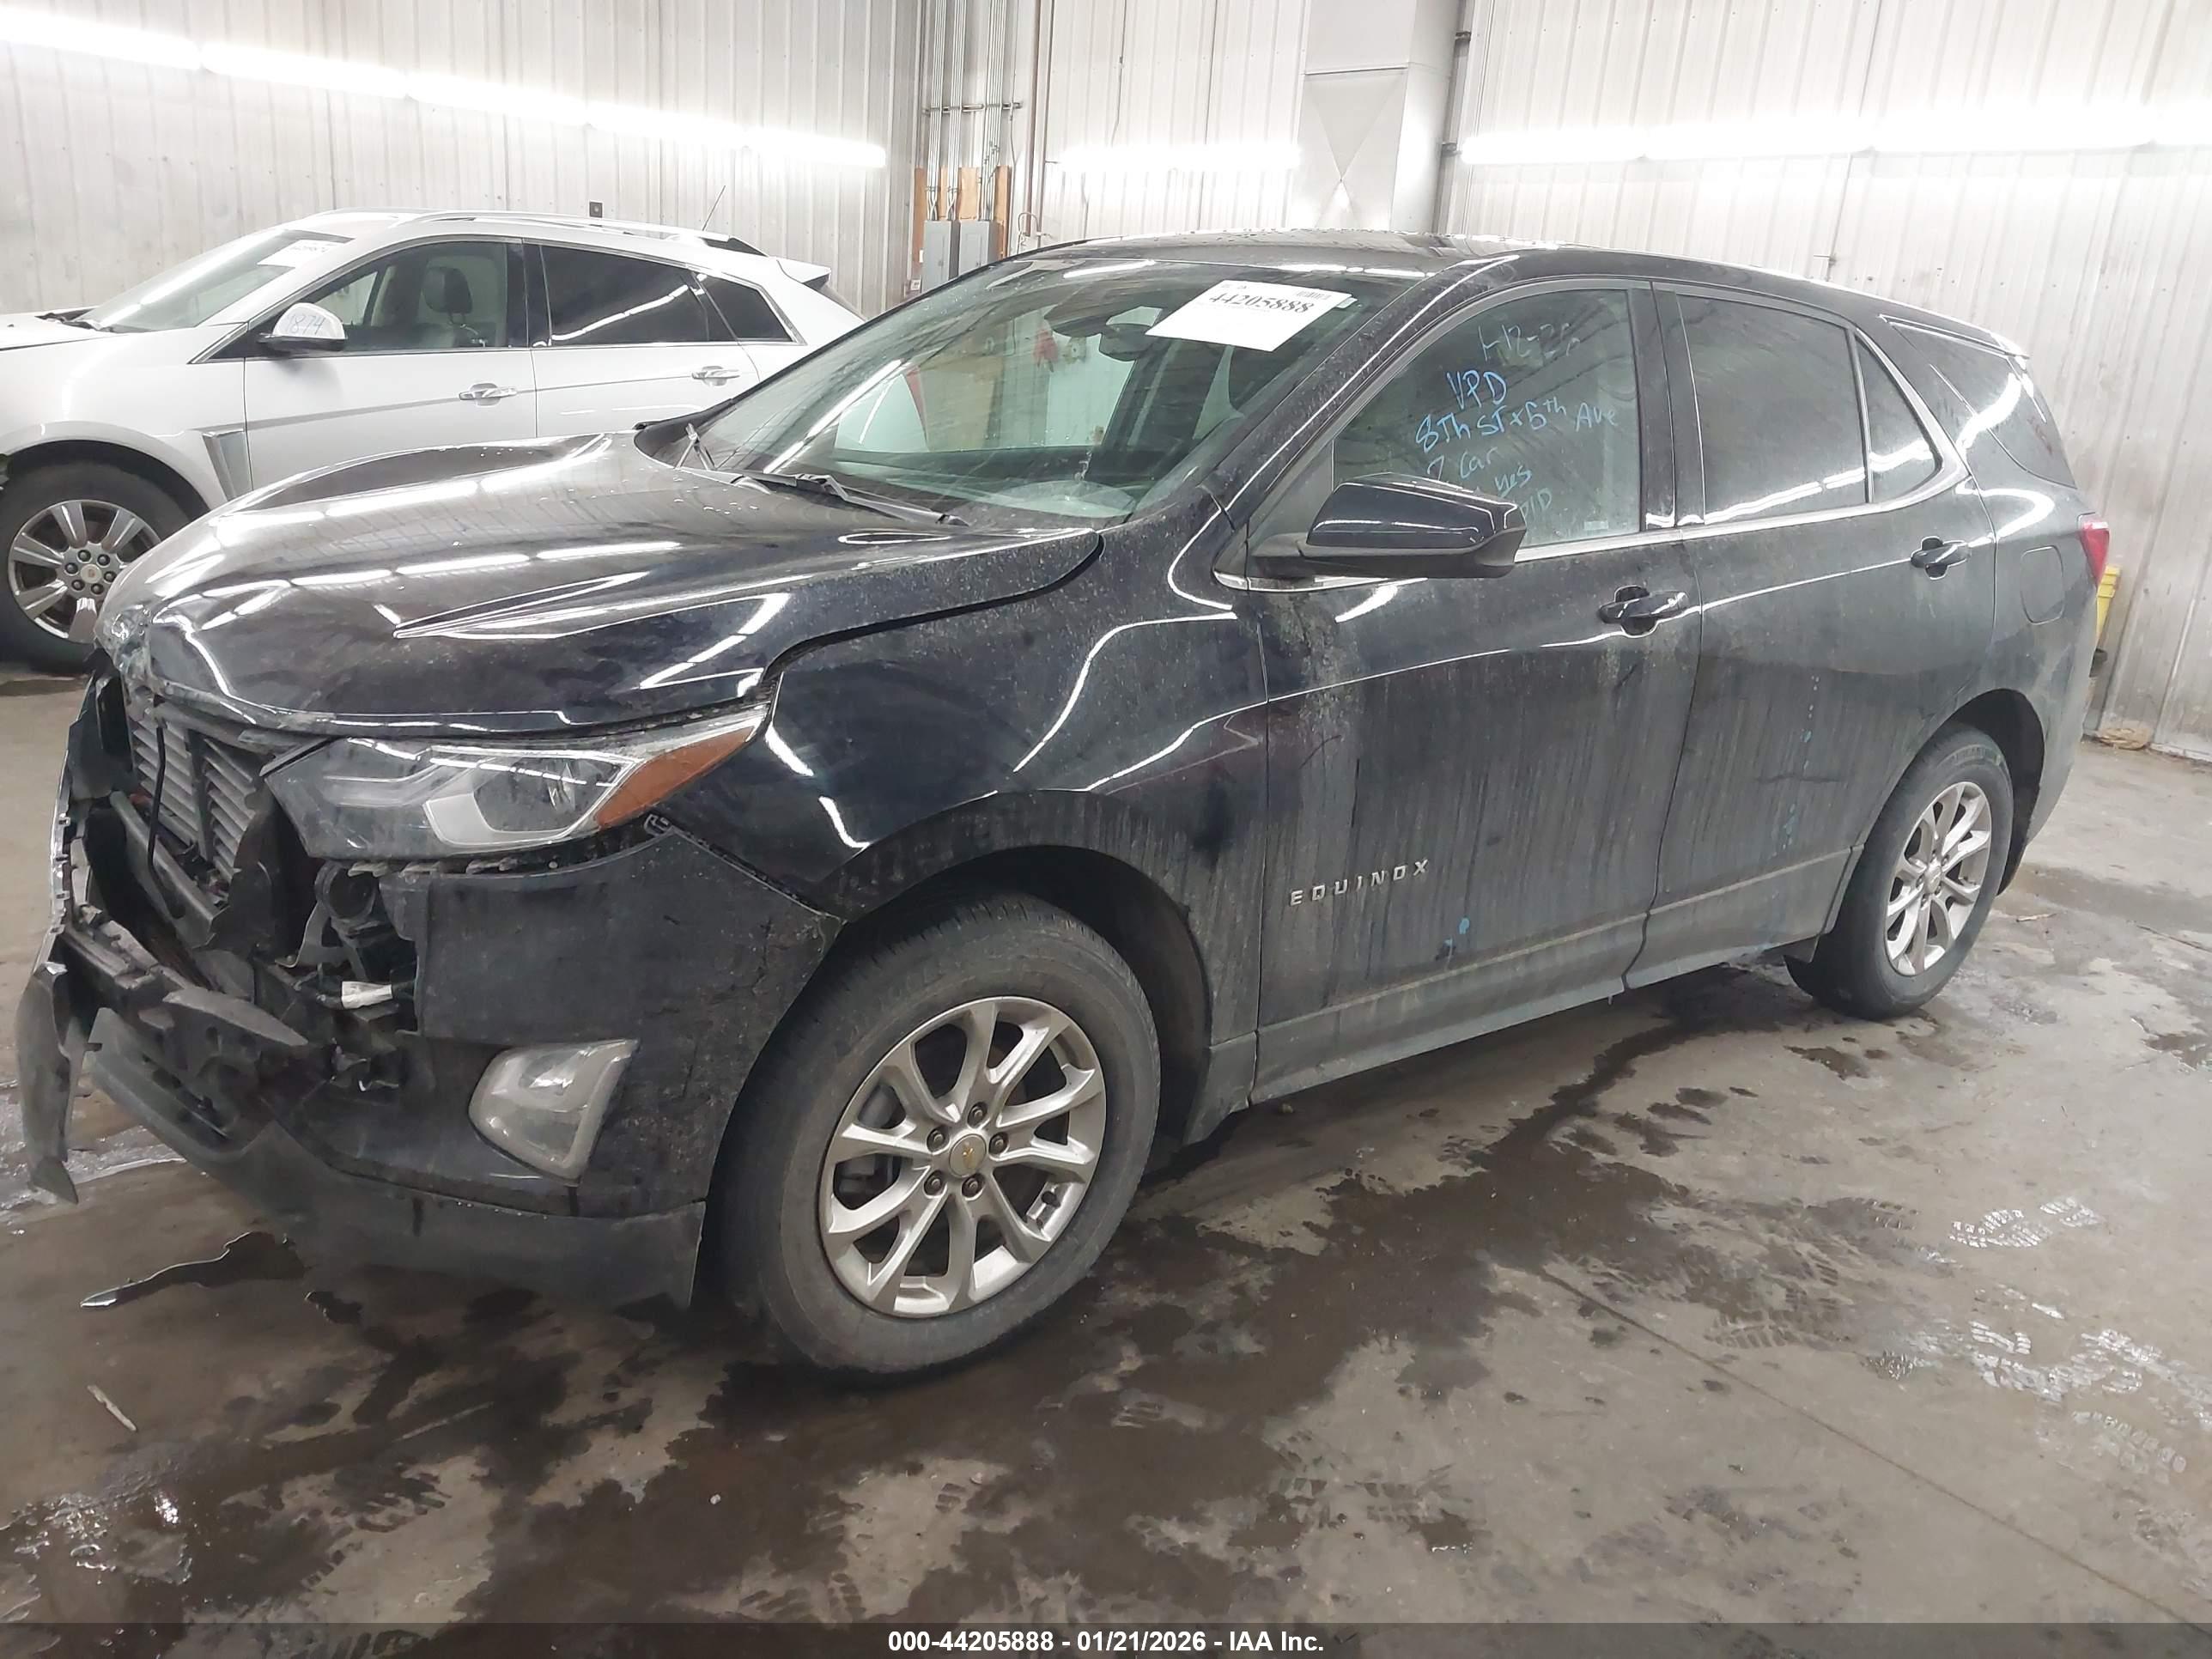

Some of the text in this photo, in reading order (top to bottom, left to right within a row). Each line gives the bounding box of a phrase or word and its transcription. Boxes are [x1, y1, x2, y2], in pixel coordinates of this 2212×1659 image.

[1208, 292, 1315, 314] 44205888
[1446, 369, 1507, 410] VPD
[1576, 402, 1619, 432] Ave
[1460, 447, 1498, 479] Car
[1290, 859, 1428, 906] EQUINOX
